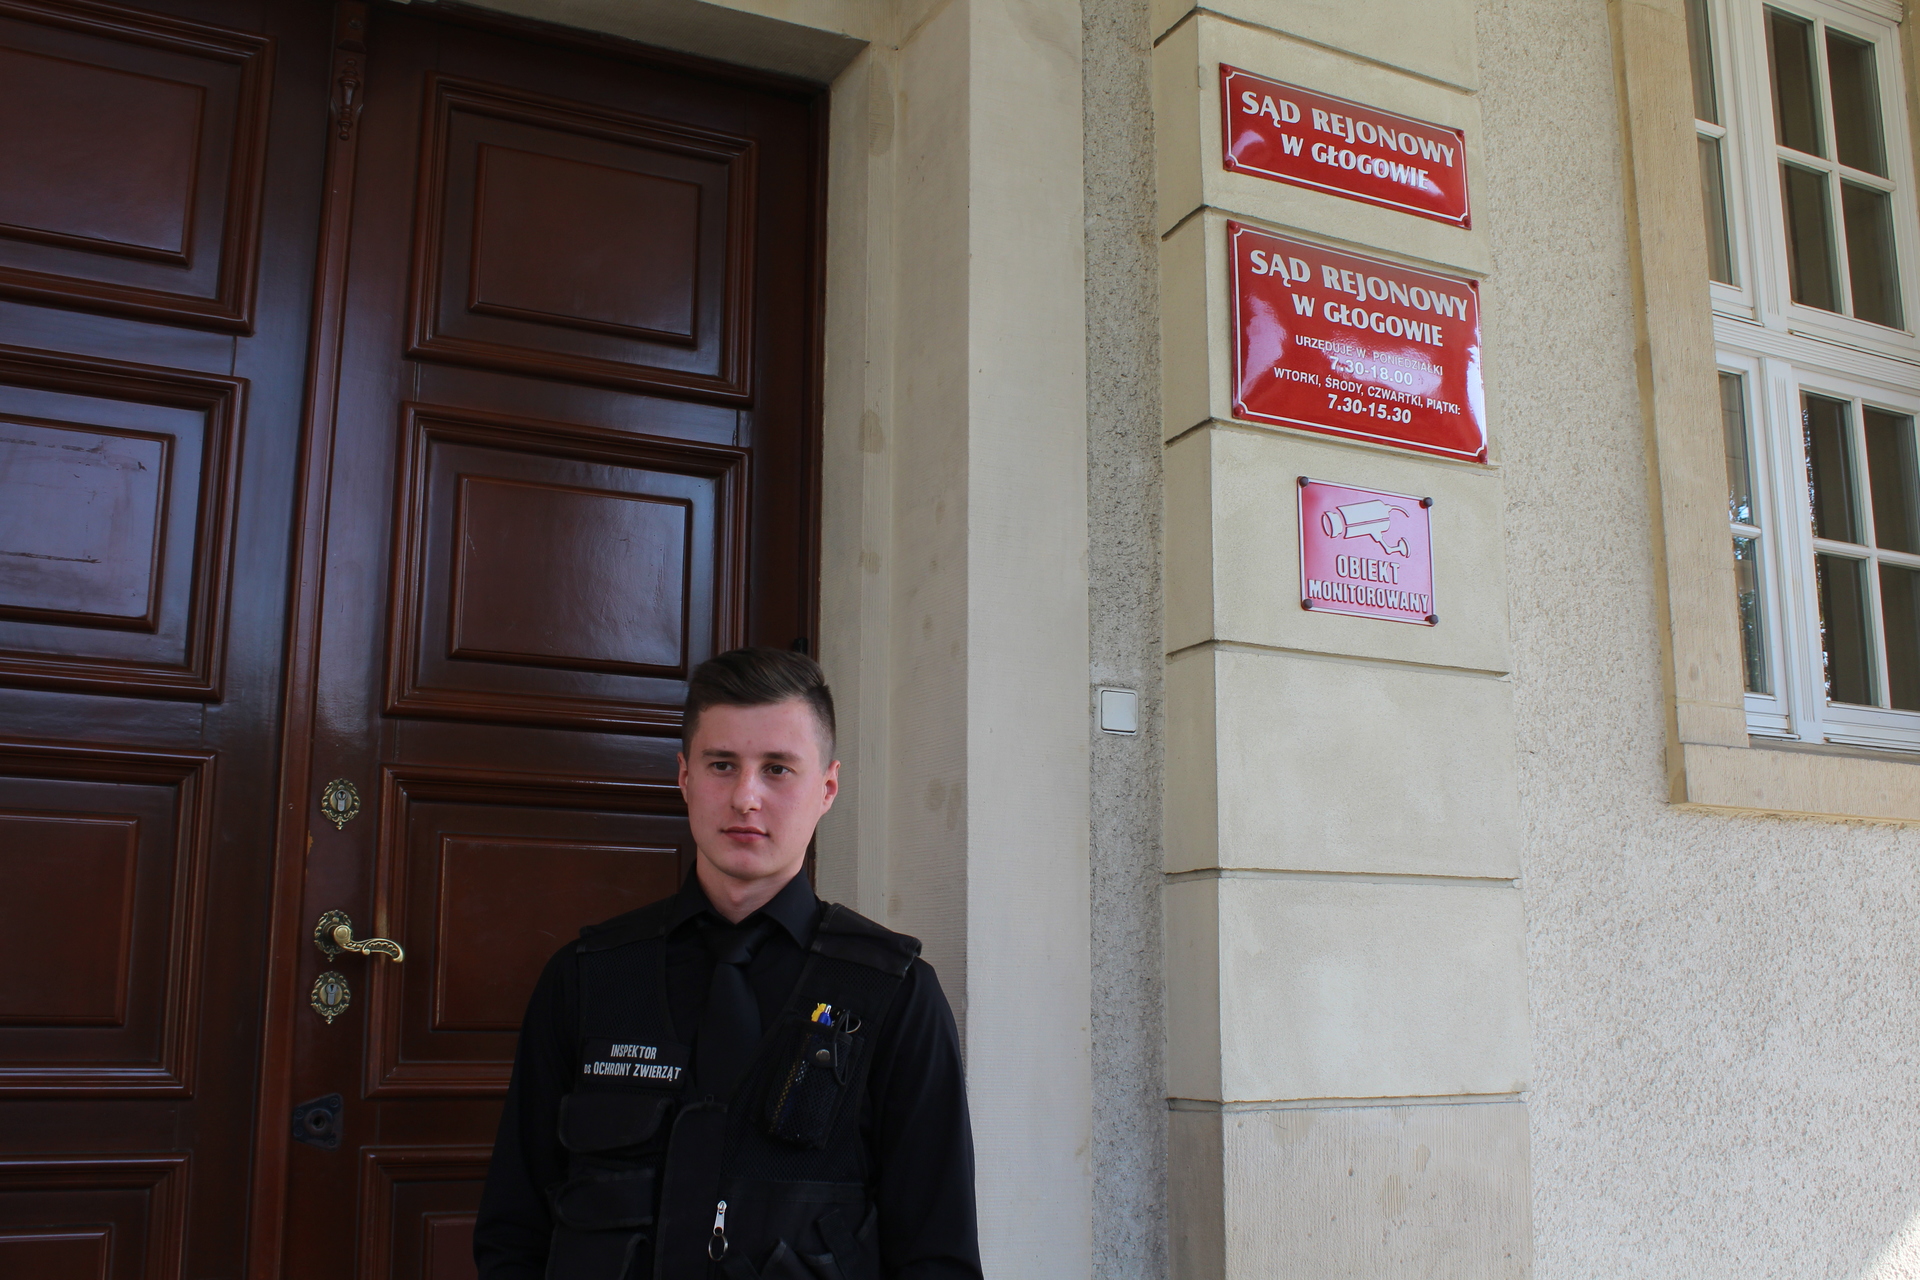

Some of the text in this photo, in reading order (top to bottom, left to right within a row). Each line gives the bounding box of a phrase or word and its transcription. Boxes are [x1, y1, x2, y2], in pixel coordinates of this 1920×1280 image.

[1241, 91, 1454, 168] SĄD REJONOWY
[1281, 133, 1429, 190] W GŁOGOWIE
[1250, 249, 1468, 321] SĄD REJONOWY
[1291, 293, 1443, 347] W GŁOGOWIE
[1295, 334, 1443, 376] URZĘDUJE W PONIEDZIAŁKI
[1330, 355, 1413, 386] 7.30-18.00
[1274, 367, 1461, 415] WTORKI, ŚRODY, CZWARTKI, PIĄTKI:
[1328, 394, 1412, 424] 7.30-15.30
[1336, 554, 1400, 585] OBIEKT
[1308, 579, 1429, 614] MONITOROWANY
[610, 1044, 657, 1060] INSPEKTOR
[593, 1061, 632, 1076] OCHRONY
[632, 1063, 682, 1082] ZWIERZĄT
